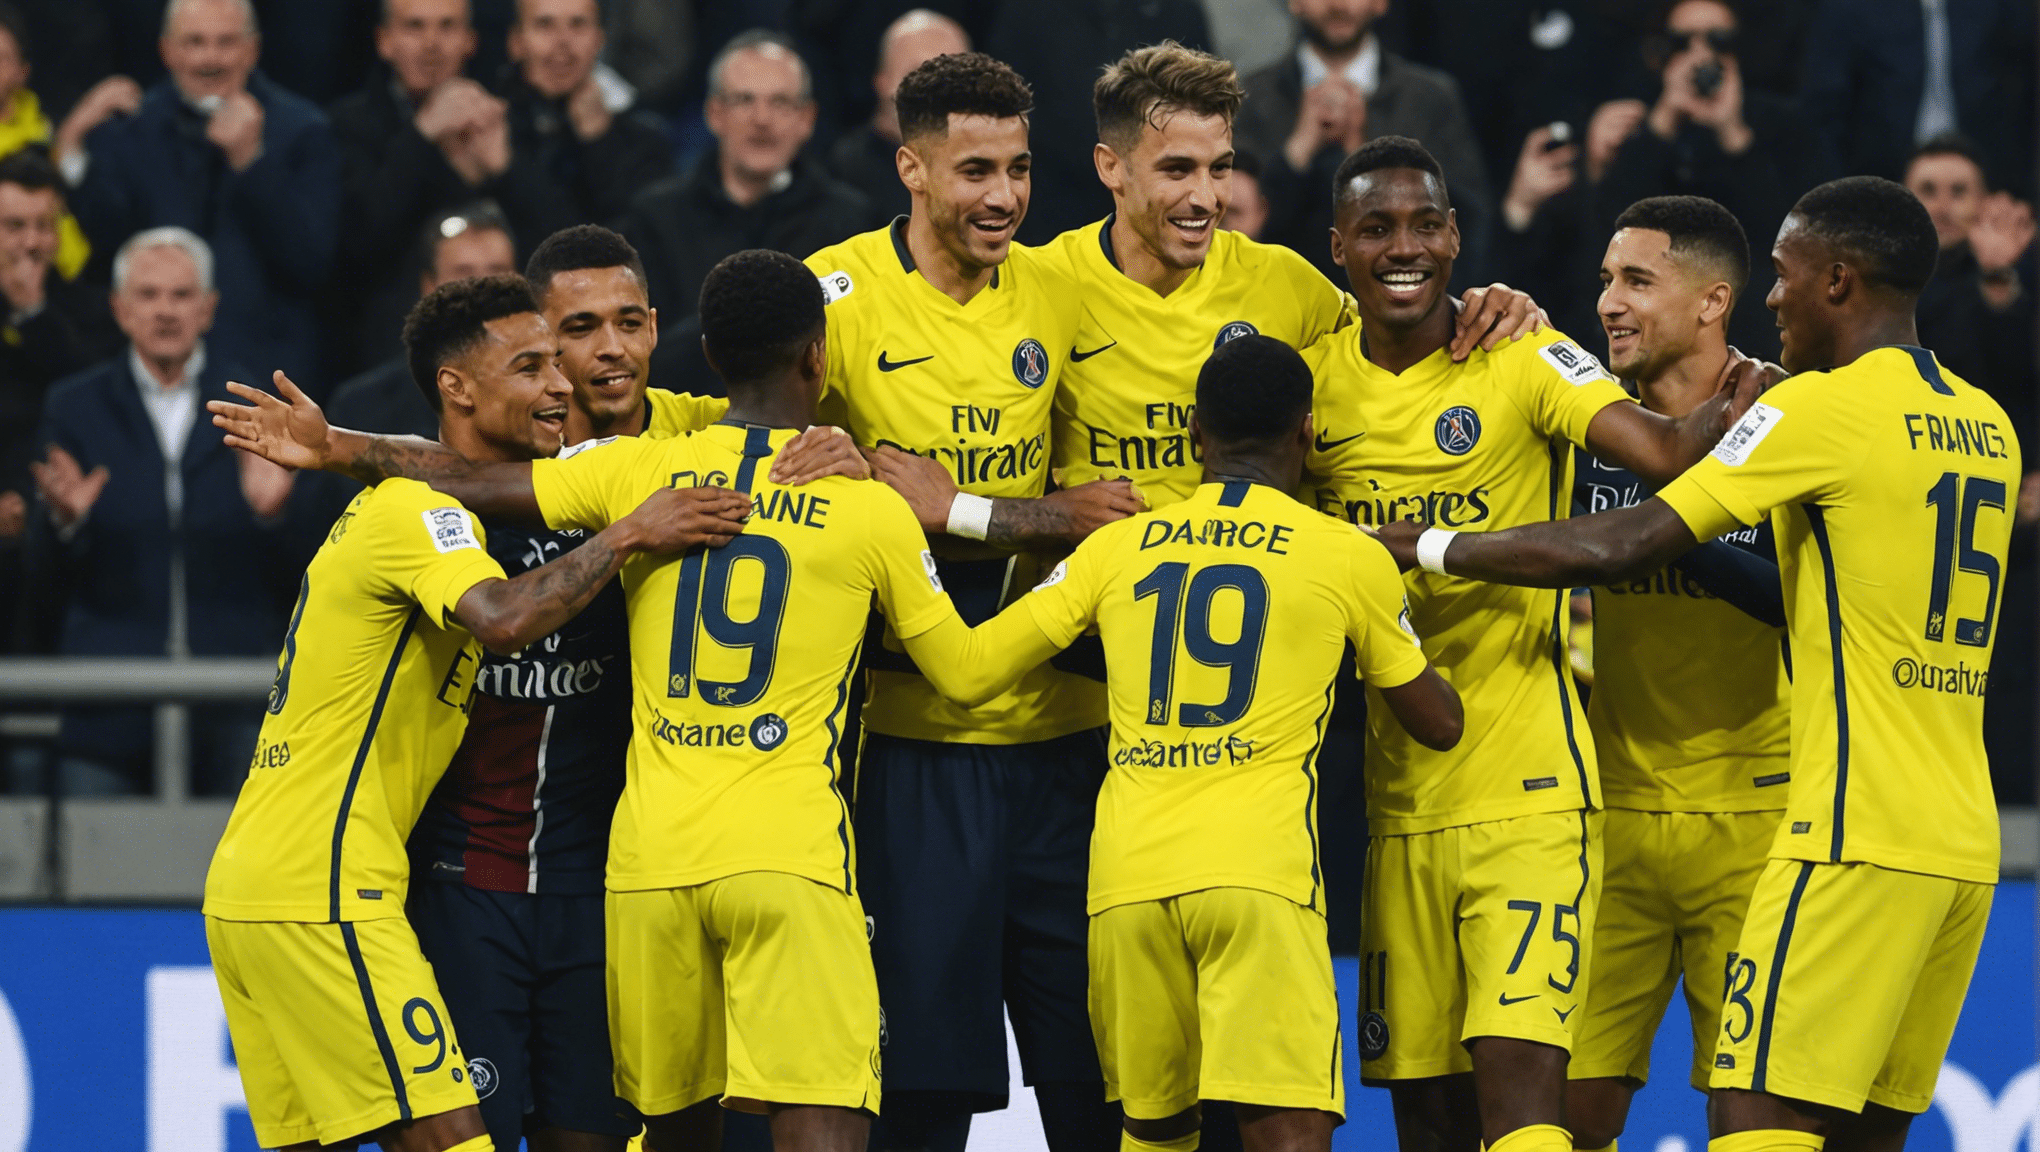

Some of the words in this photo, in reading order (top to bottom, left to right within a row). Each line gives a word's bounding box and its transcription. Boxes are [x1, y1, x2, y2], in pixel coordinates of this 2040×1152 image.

[666, 533, 793, 707] 19
[1925, 472, 2006, 648] 15
[1133, 561, 1271, 728] 19
[1506, 900, 1581, 994] 75
[401, 996, 447, 1075] 9
